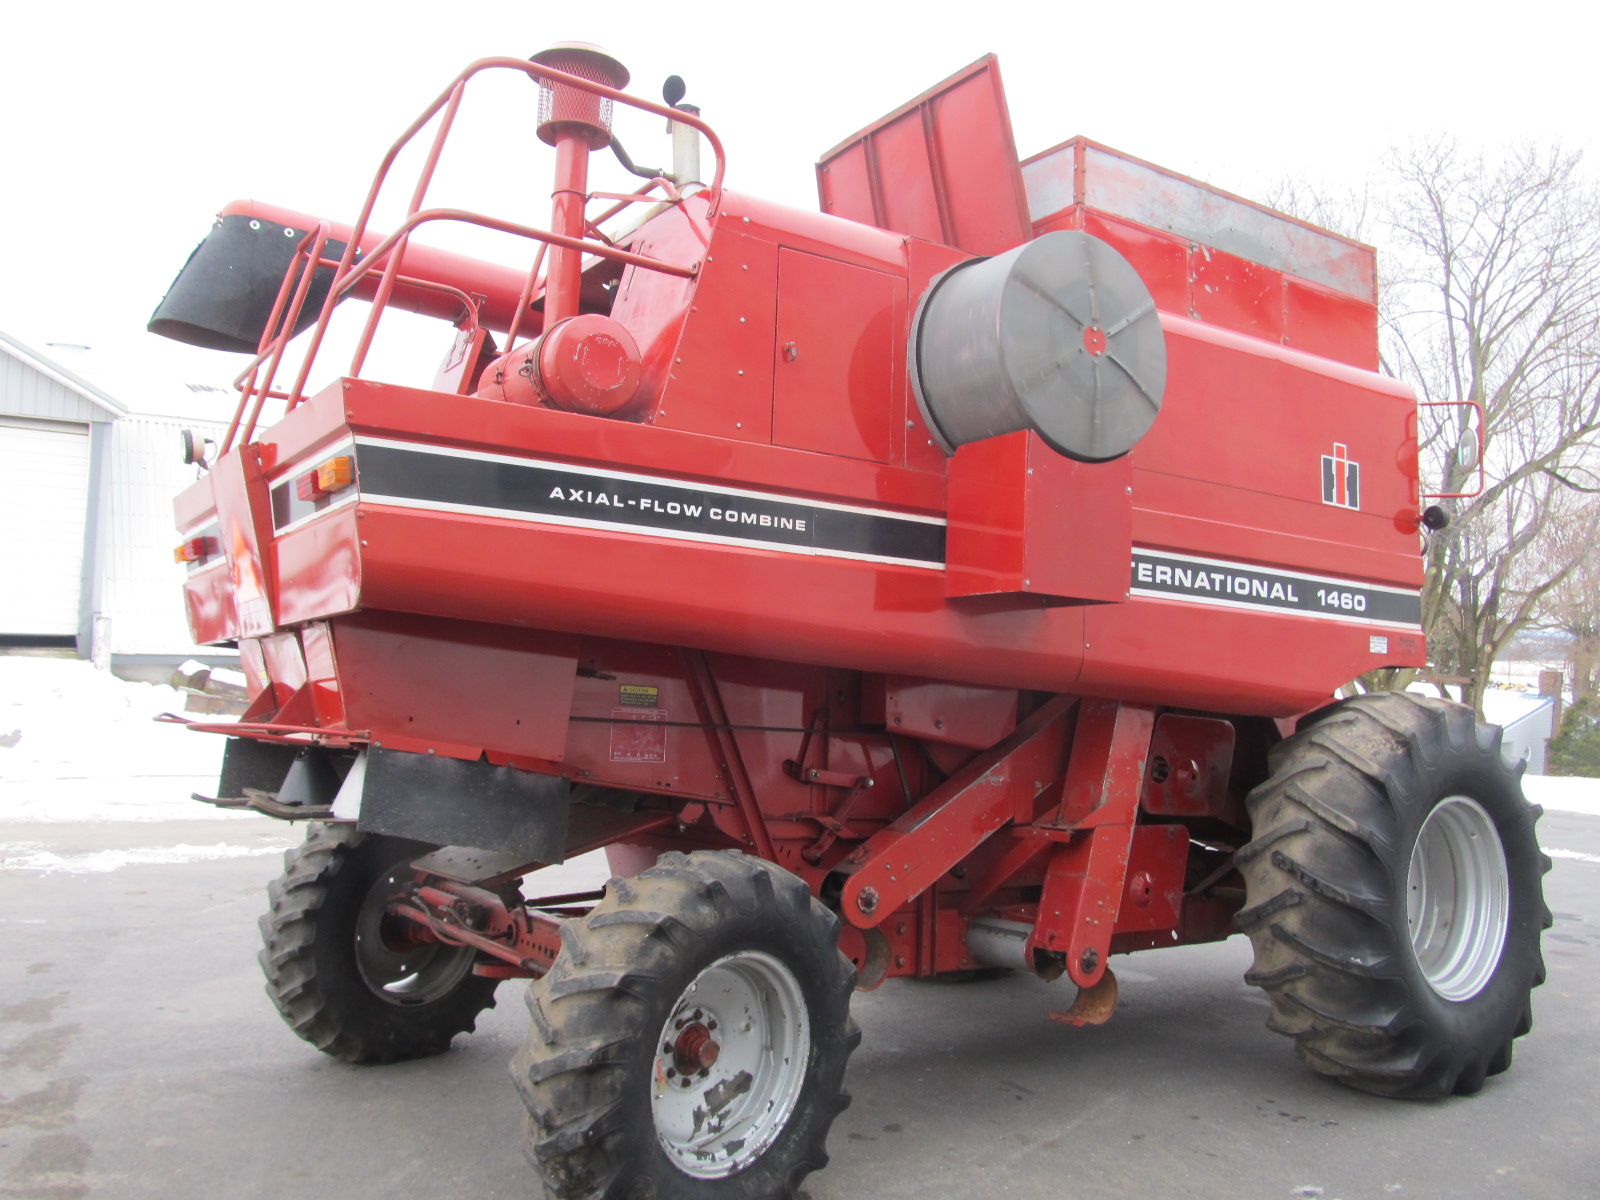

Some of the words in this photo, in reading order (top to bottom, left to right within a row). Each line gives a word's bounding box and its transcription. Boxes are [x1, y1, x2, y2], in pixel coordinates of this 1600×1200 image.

[549, 486, 703, 518] AXIAL-FLOW
[709, 508, 807, 532] COMBINE
[1131, 561, 1299, 603] ERNATIONAL
[1316, 589, 1367, 612] 1460
